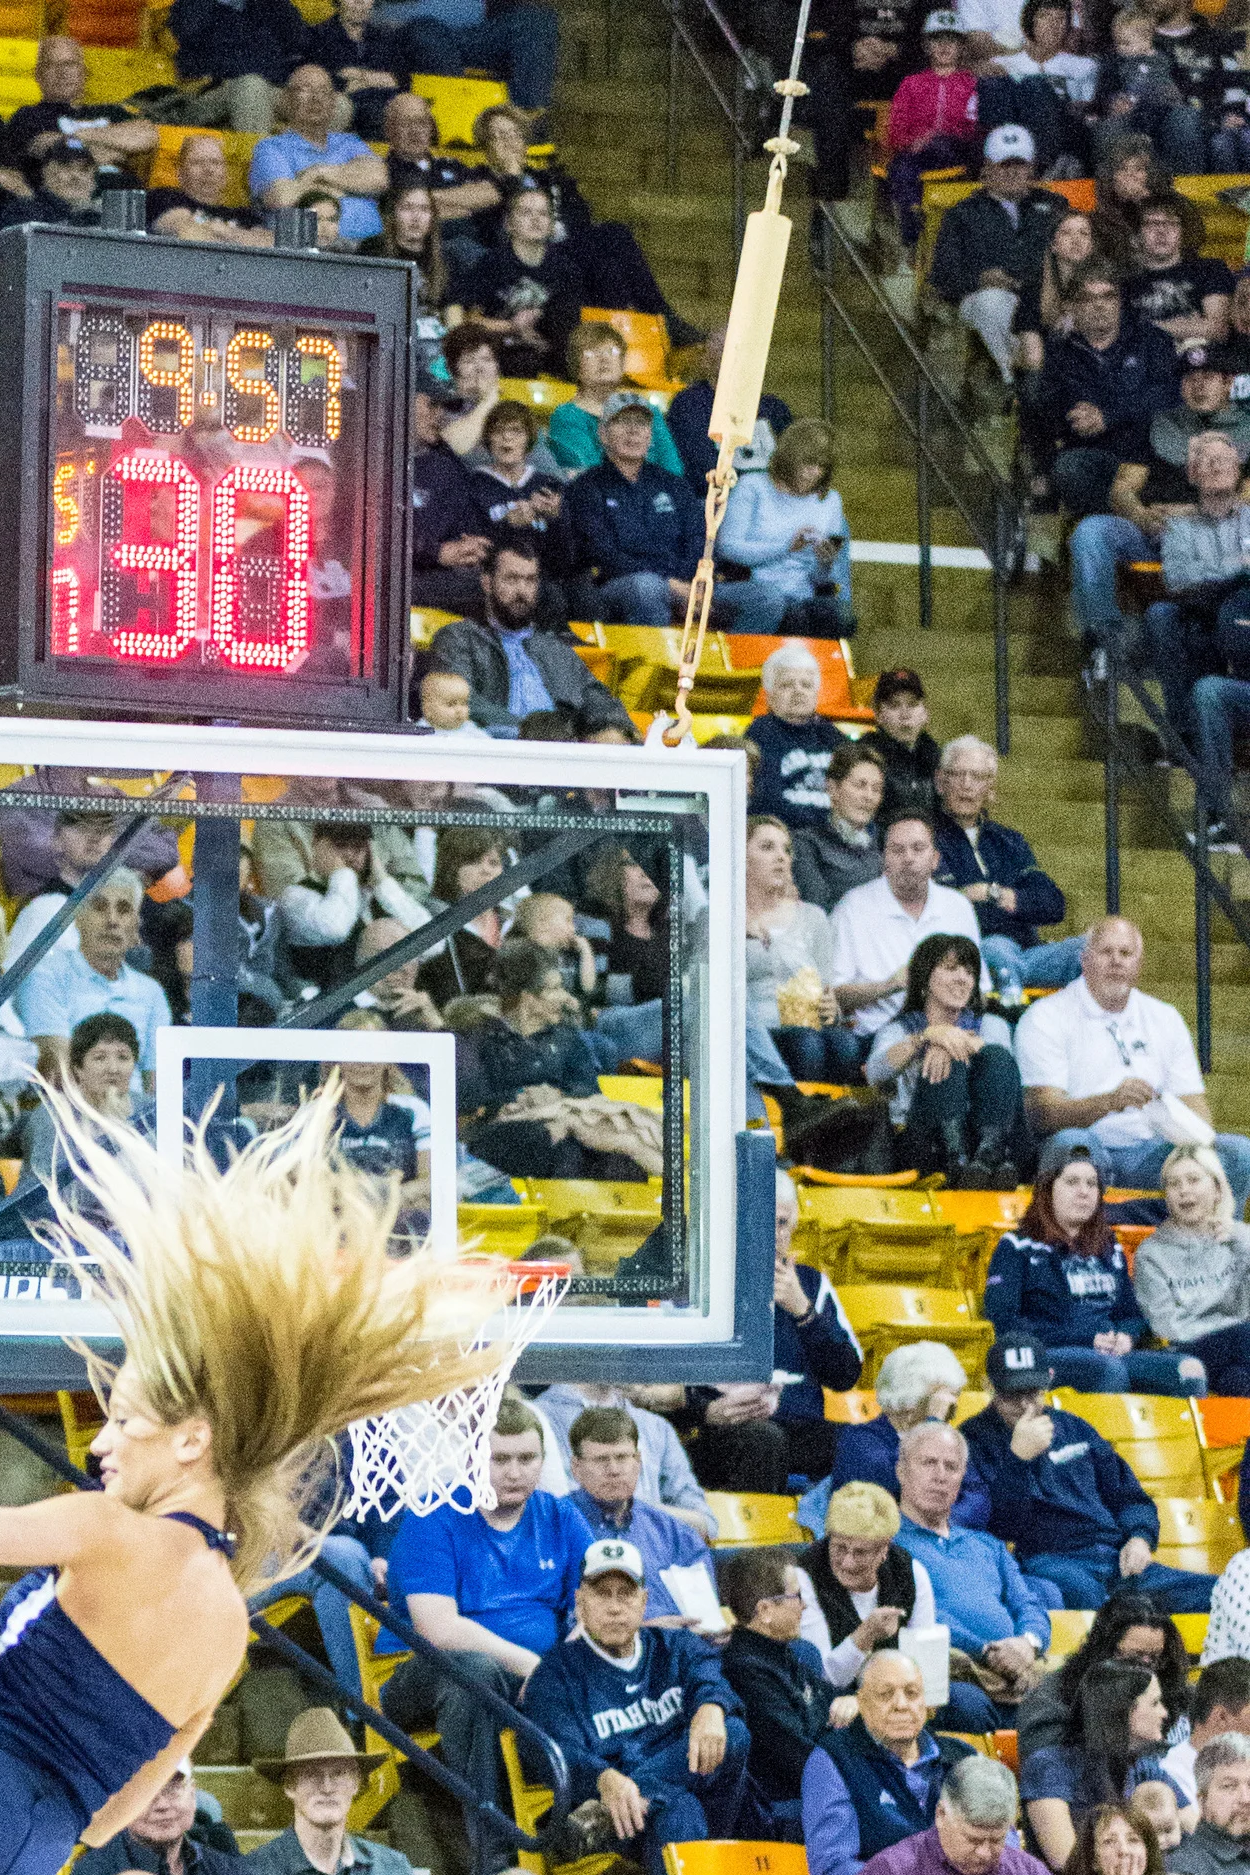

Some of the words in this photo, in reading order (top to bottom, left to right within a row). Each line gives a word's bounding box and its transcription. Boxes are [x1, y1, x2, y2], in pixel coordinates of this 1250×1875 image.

[139, 321, 341, 443] 9:57
[110, 456, 311, 667] 30
[592, 1701, 647, 1739] UTAH
